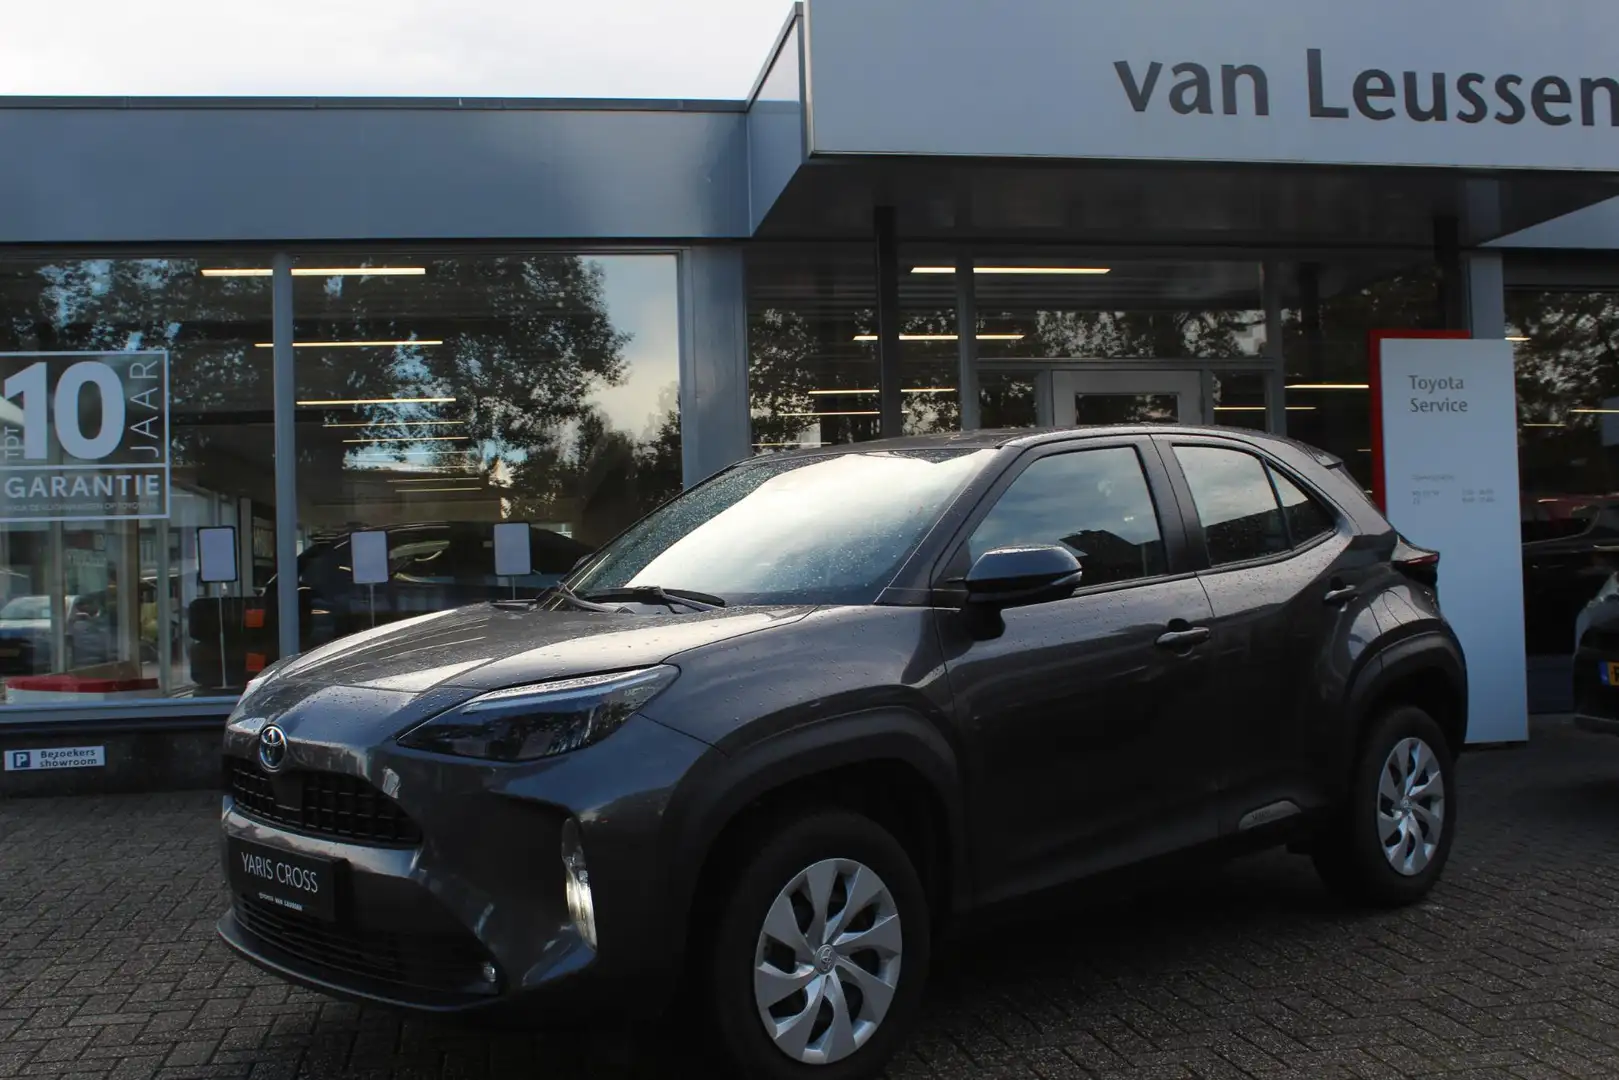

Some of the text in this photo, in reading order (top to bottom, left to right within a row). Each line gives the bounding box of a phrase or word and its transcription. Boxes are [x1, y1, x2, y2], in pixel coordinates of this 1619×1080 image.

[1113, 48, 1619, 127] van Leussen
[1408, 375, 1464, 394] Toyota
[4, 361, 126, 459] 10
[130, 360, 159, 458] JAAR
[1410, 398, 1468, 412] Service
[4, 474, 160, 498] GARANTIE
[40, 748, 96, 760] Bezoekers
[40, 758, 97, 768] showroom
[241, 851, 318, 893] YARIS CROSS
